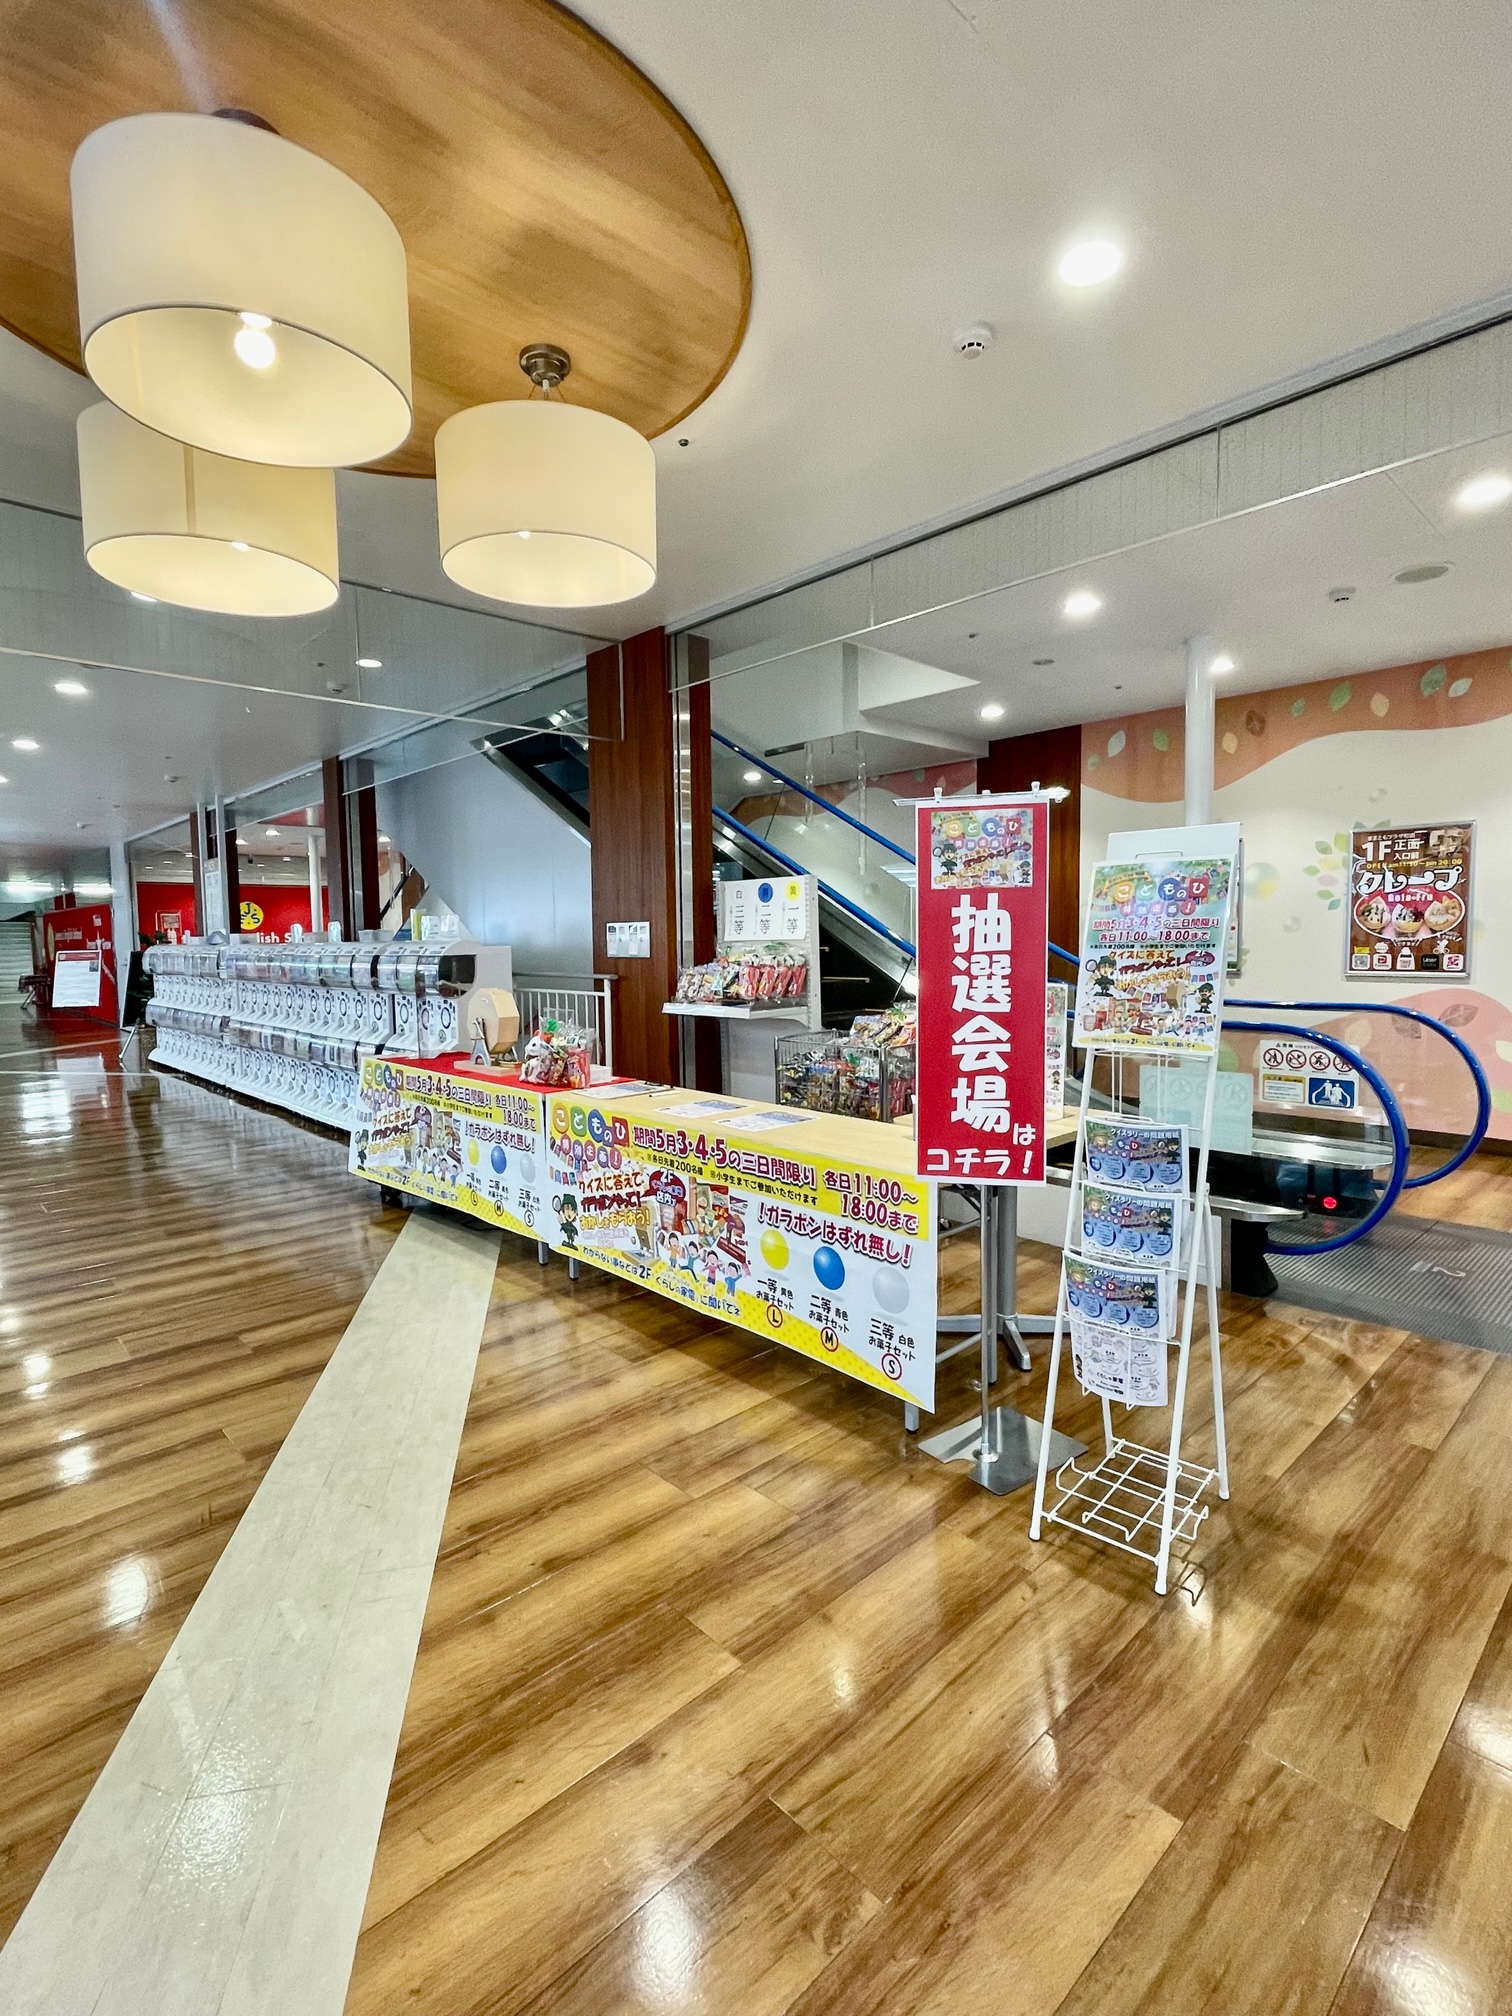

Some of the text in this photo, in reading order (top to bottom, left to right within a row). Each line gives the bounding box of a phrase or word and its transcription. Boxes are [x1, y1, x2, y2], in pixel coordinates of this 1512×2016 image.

[948, 821, 1019, 836] こどものひ
[1361, 840, 1392, 862] 1F
[1394, 839, 1420, 851] 正面
[1117, 881, 1206, 898] こどものひ
[1357, 866, 1463, 896] クレープ
[1109, 950, 1176, 960] クイズに答えて
[950, 892, 1013, 1134] 抽選会場
[555, 1107, 628, 1144] こどものひ
[632, 1125, 817, 1192] 期間5月3・4・5の三日間限り
[926, 1146, 1034, 1177] コチラ!
[578, 1171, 643, 1194] クイズに答えて
[840, 1193, 920, 1234] 18:00まで
[756, 1277, 778, 1295] 一等
[755, 1289, 795, 1312] お菓子セット
[809, 1294, 849, 1322] 二等 青色
[808, 1308, 850, 1334] お菓子セット
[869, 1317, 915, 1349] 三等 白色
[868, 1335, 917, 1362] お菓子セット
